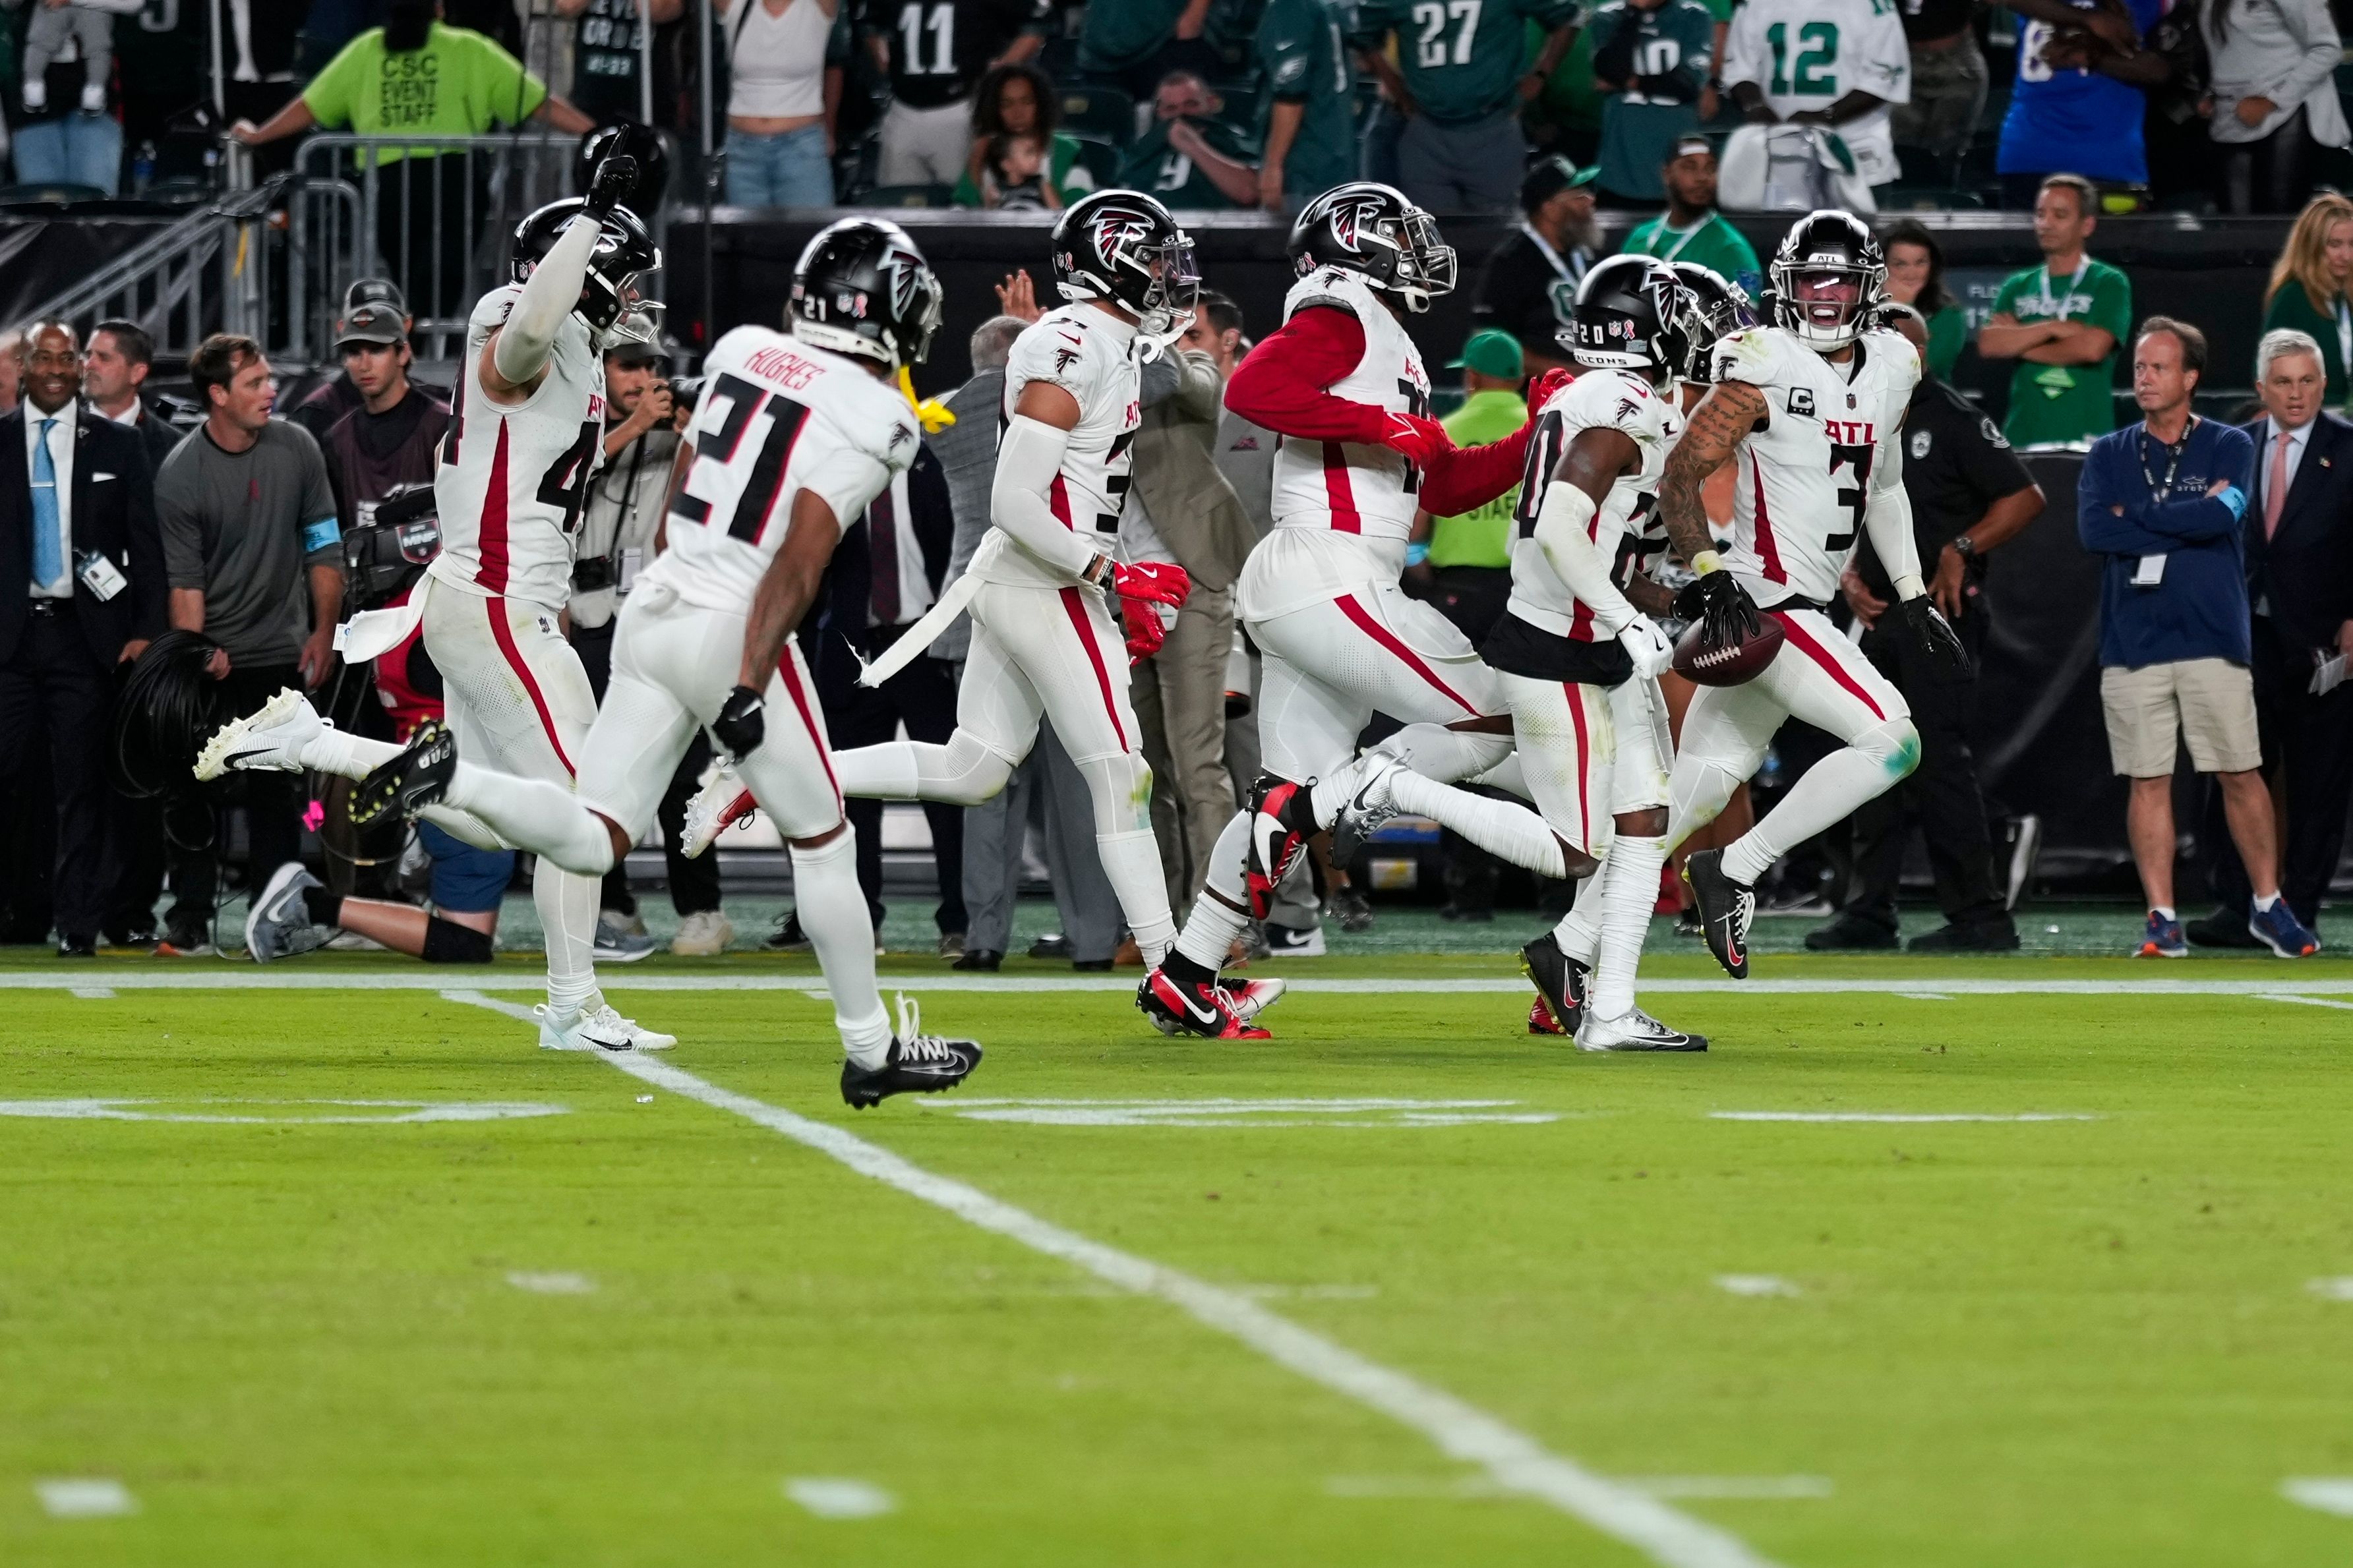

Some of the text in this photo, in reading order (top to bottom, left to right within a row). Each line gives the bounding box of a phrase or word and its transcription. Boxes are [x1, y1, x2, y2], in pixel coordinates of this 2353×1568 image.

[897, 3, 958, 75] 11
[1412, 0, 1481, 68] 27
[382, 53, 438, 77] CSC
[1768, 22, 1838, 95] 12
[381, 78, 438, 103] EVENT
[380, 103, 436, 127] STAFF
[804, 294, 826, 322] 21
[1580, 324, 1604, 344] 20
[743, 347, 827, 390] HUGHES
[1574, 353, 1628, 365] ALCONS
[1790, 389, 1813, 409] C
[1825, 419, 1878, 445] ATL
[669, 372, 812, 547] 21
[1825, 443, 1874, 552] 3
